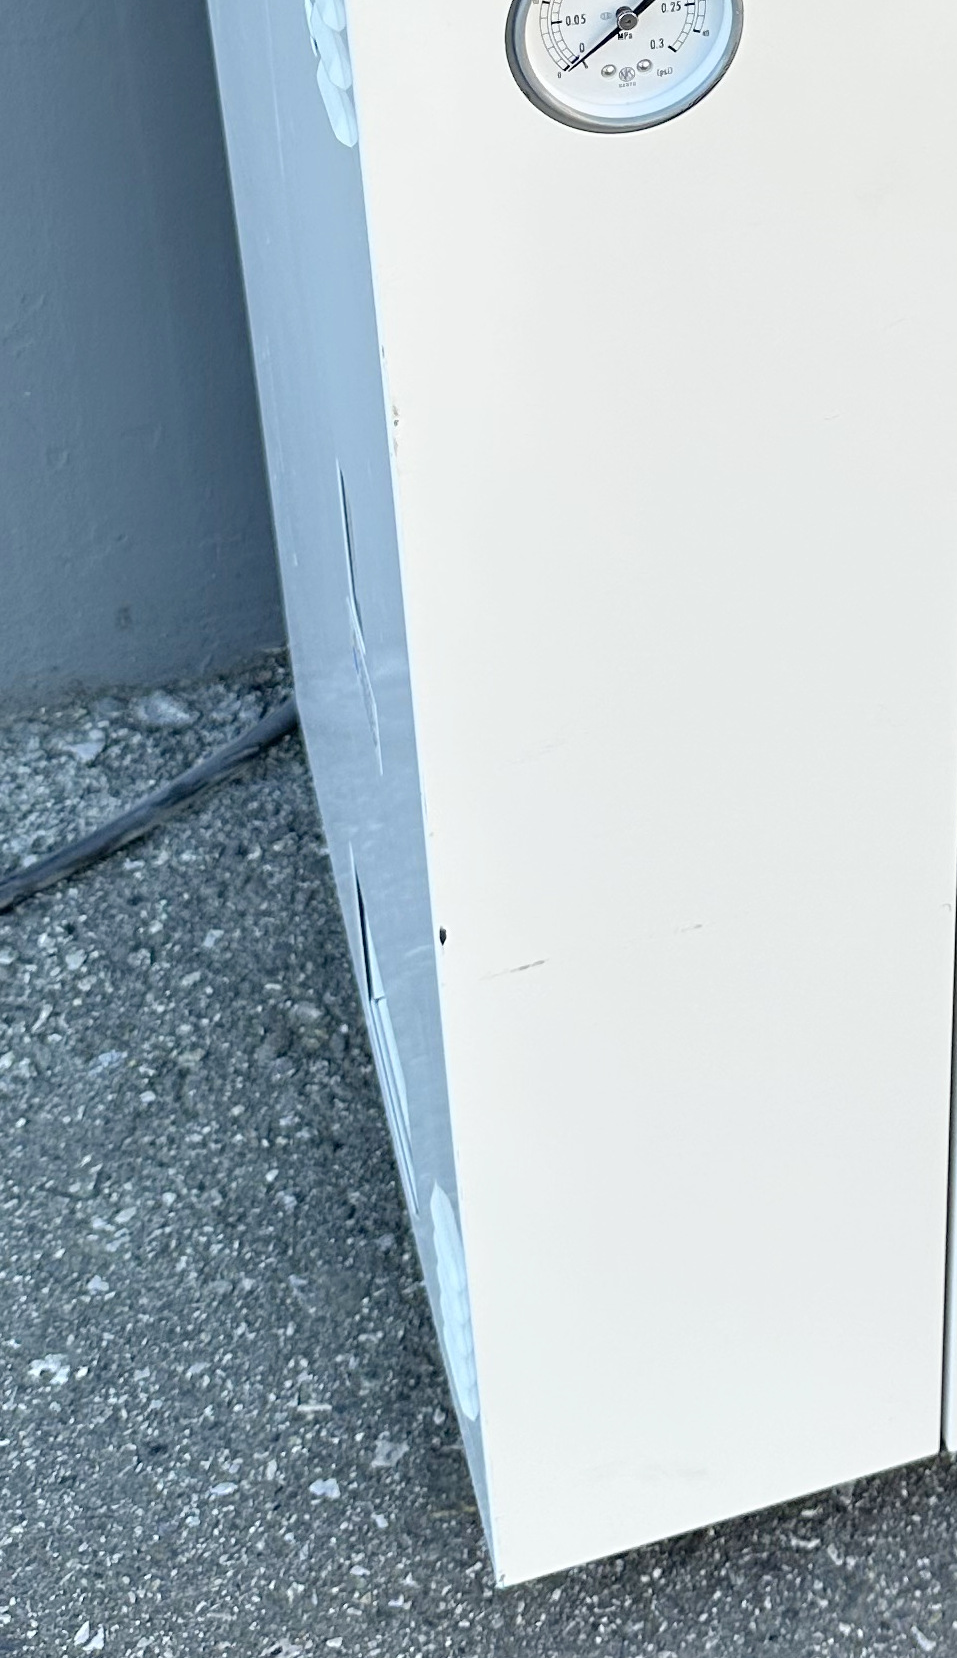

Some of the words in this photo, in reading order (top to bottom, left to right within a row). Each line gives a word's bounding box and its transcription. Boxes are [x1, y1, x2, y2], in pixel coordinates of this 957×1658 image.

[661, 1, 682, 14] 0.25
[565, 14, 586, 27] 0.05
[617, 31, 633, 40] MPa
[579, 42, 585, 53] 0
[650, 38, 665, 50] 0.3
